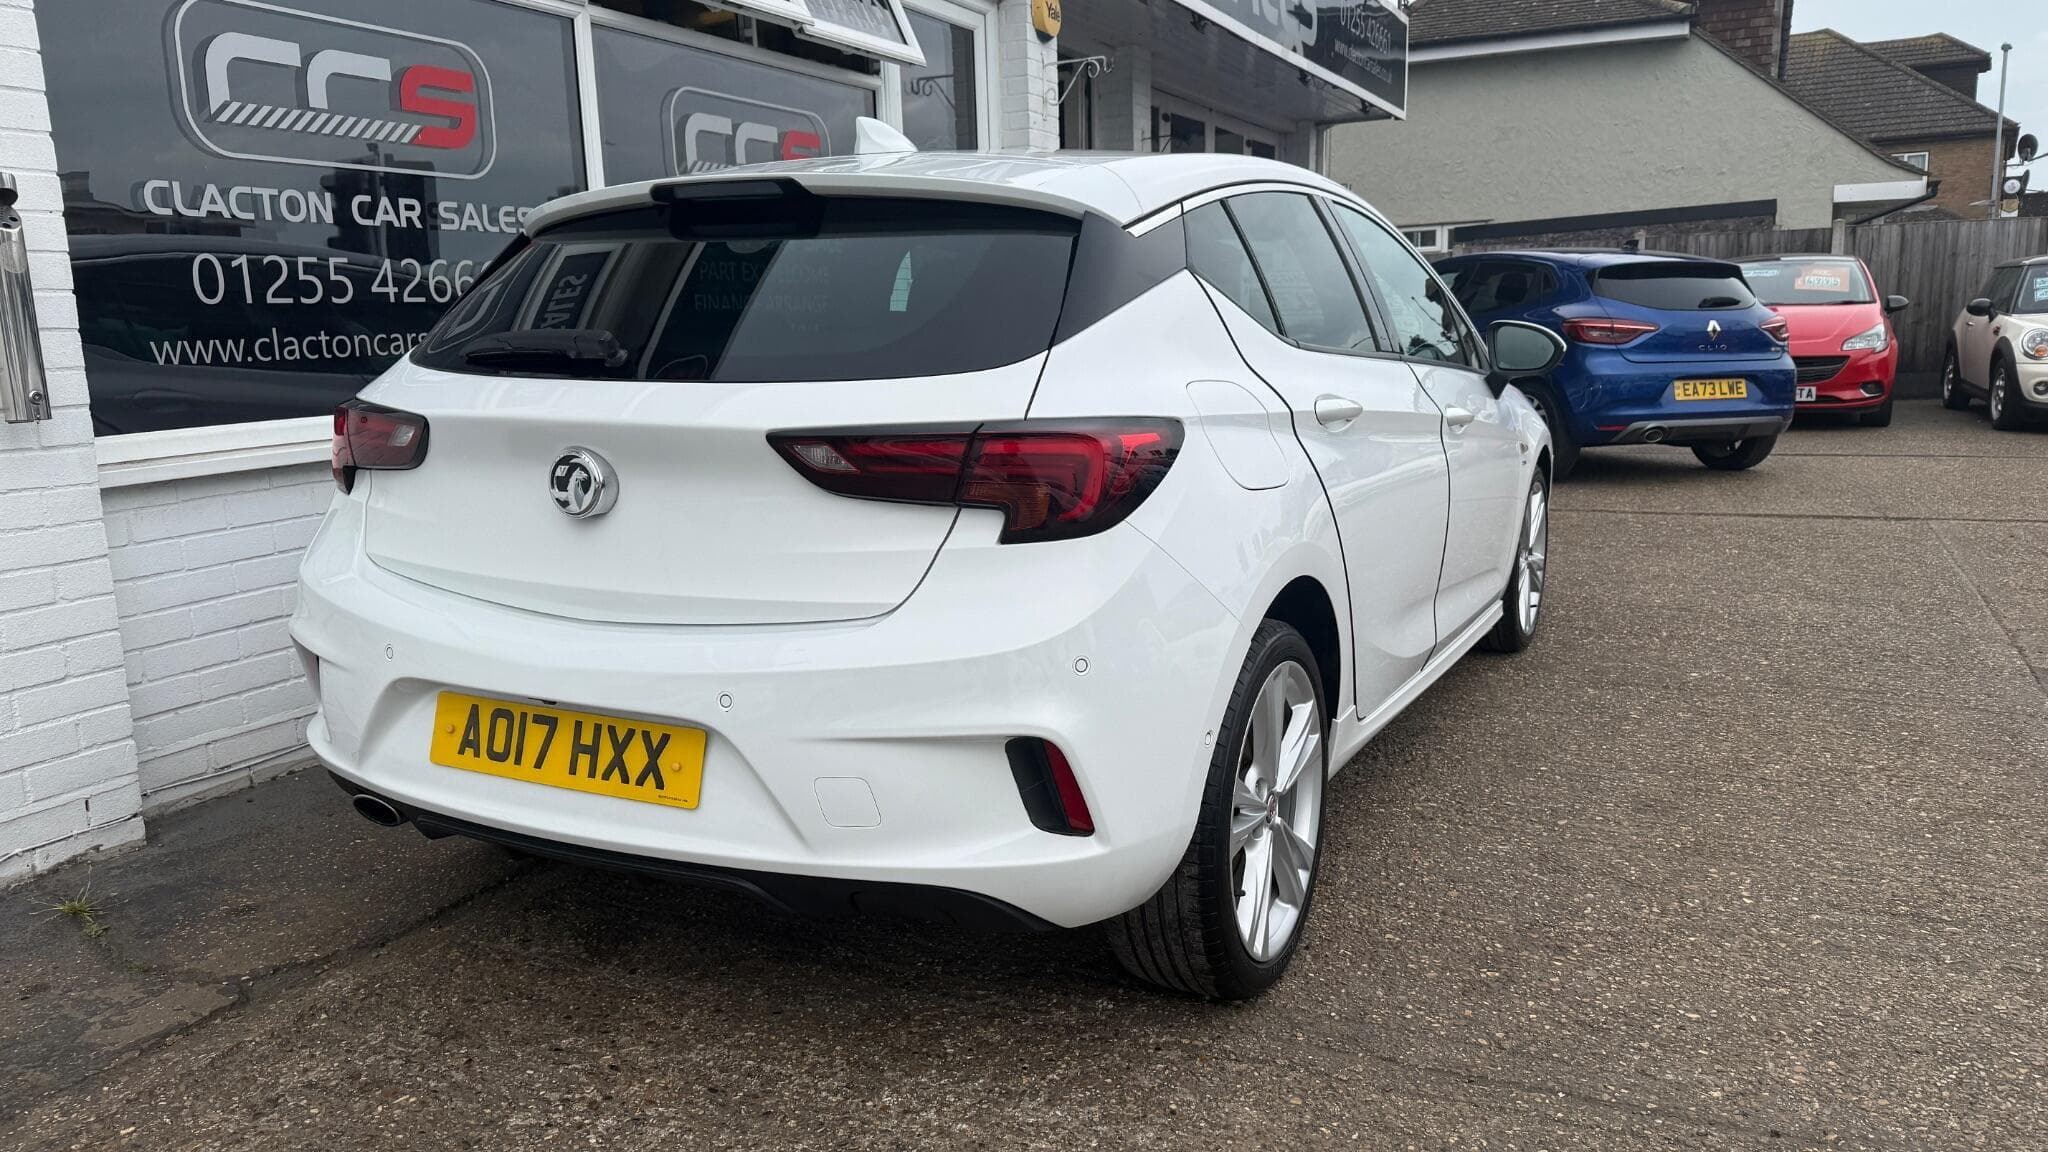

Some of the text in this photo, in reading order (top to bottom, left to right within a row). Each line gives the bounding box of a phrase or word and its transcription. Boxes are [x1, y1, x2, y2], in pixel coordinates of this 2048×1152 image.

[1045, 0, 1060, 23] Yale
[144, 179, 535, 234] CLACTON CAR SALES
[192, 252, 494, 305] 01255 4266
[1682, 381, 1744, 397] EA73 LWE
[1797, 387, 1814, 399] TA
[568, 719, 671, 790] HXX
